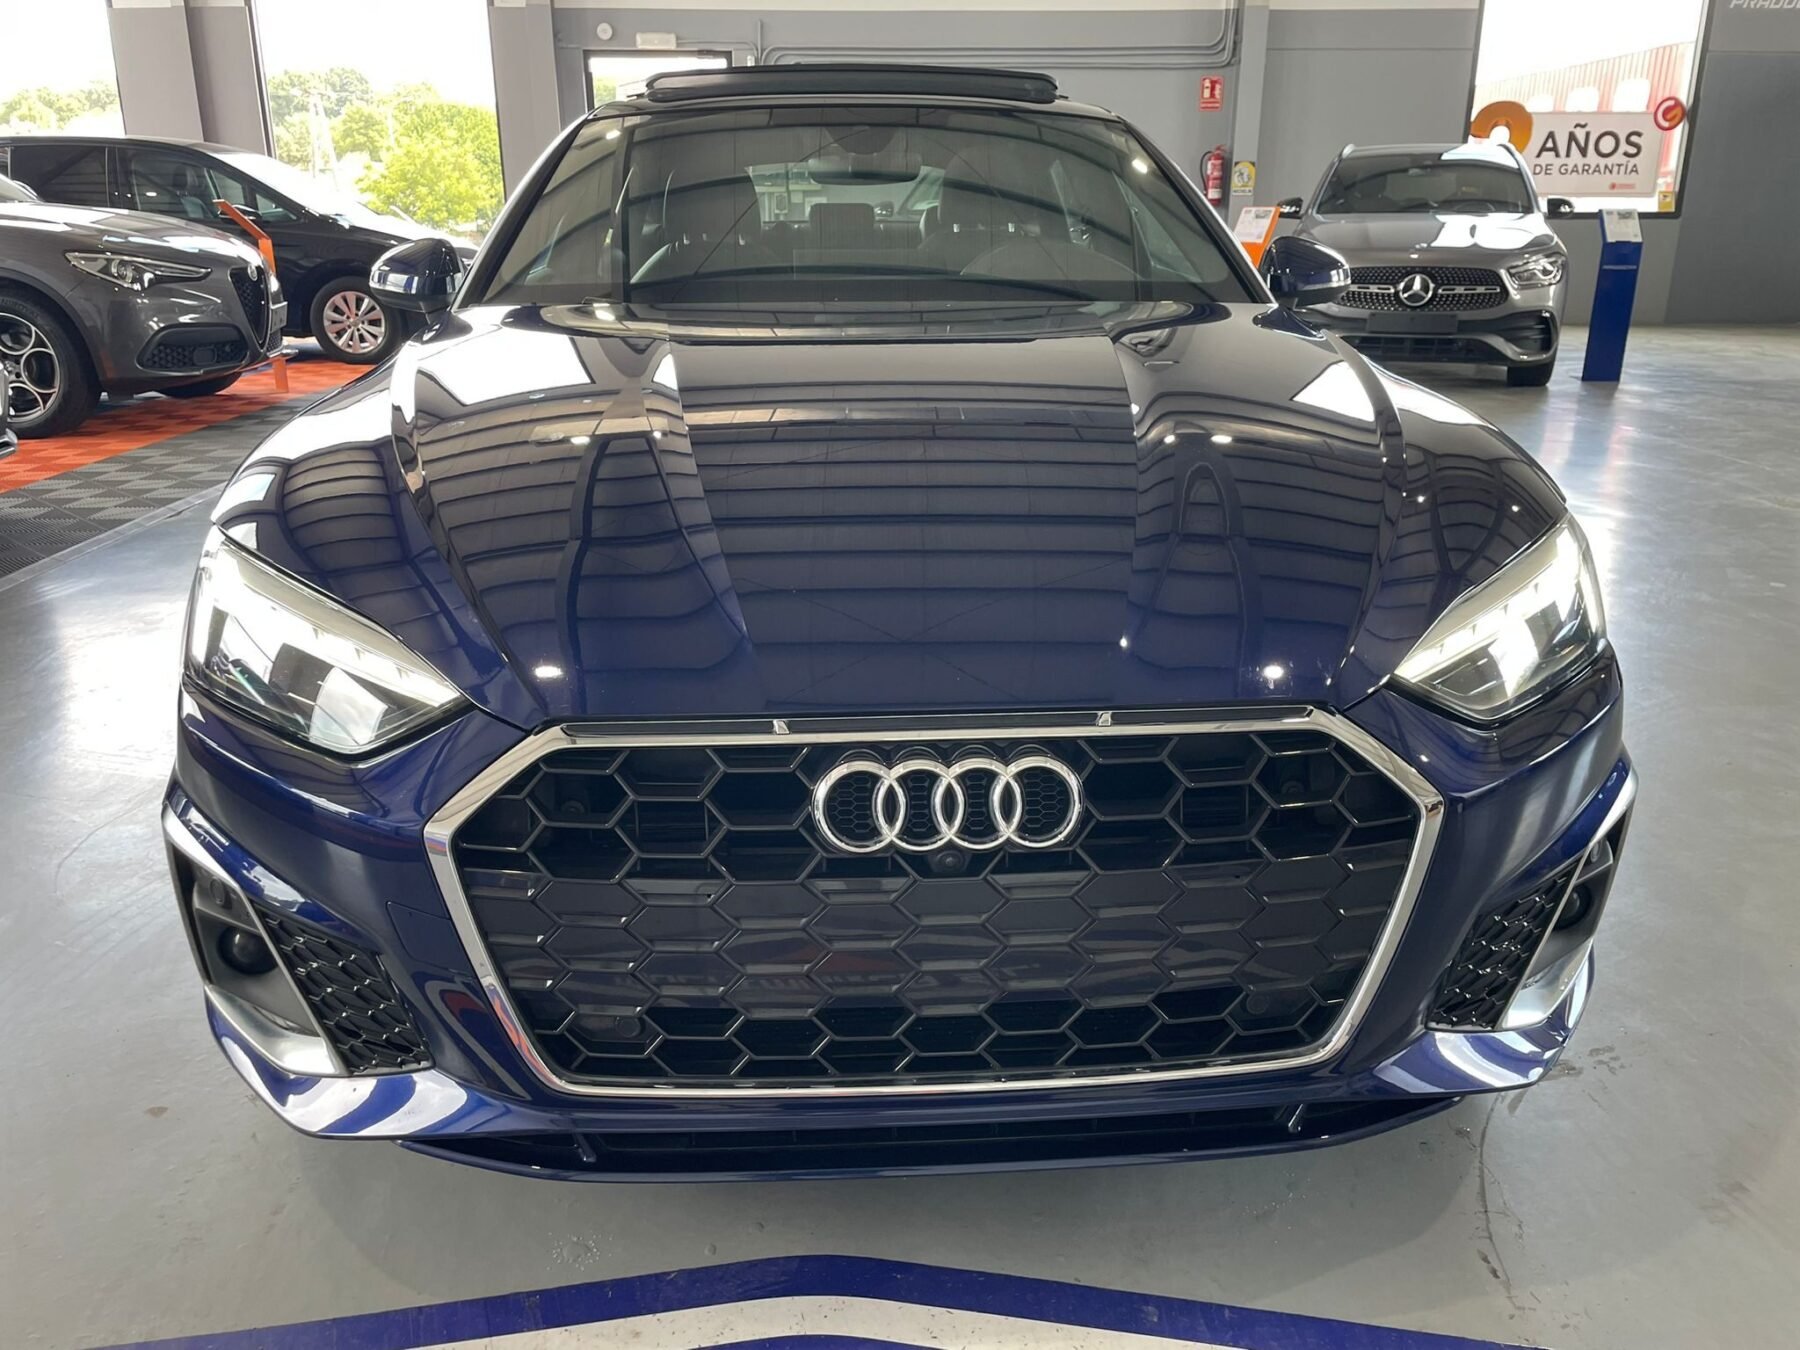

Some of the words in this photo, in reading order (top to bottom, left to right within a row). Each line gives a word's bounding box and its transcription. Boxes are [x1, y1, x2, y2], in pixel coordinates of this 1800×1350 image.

[1535, 122, 1644, 158] AÑOS
[1532, 163, 1554, 175] DE
[1558, 160, 1639, 175] GARANTÍA
